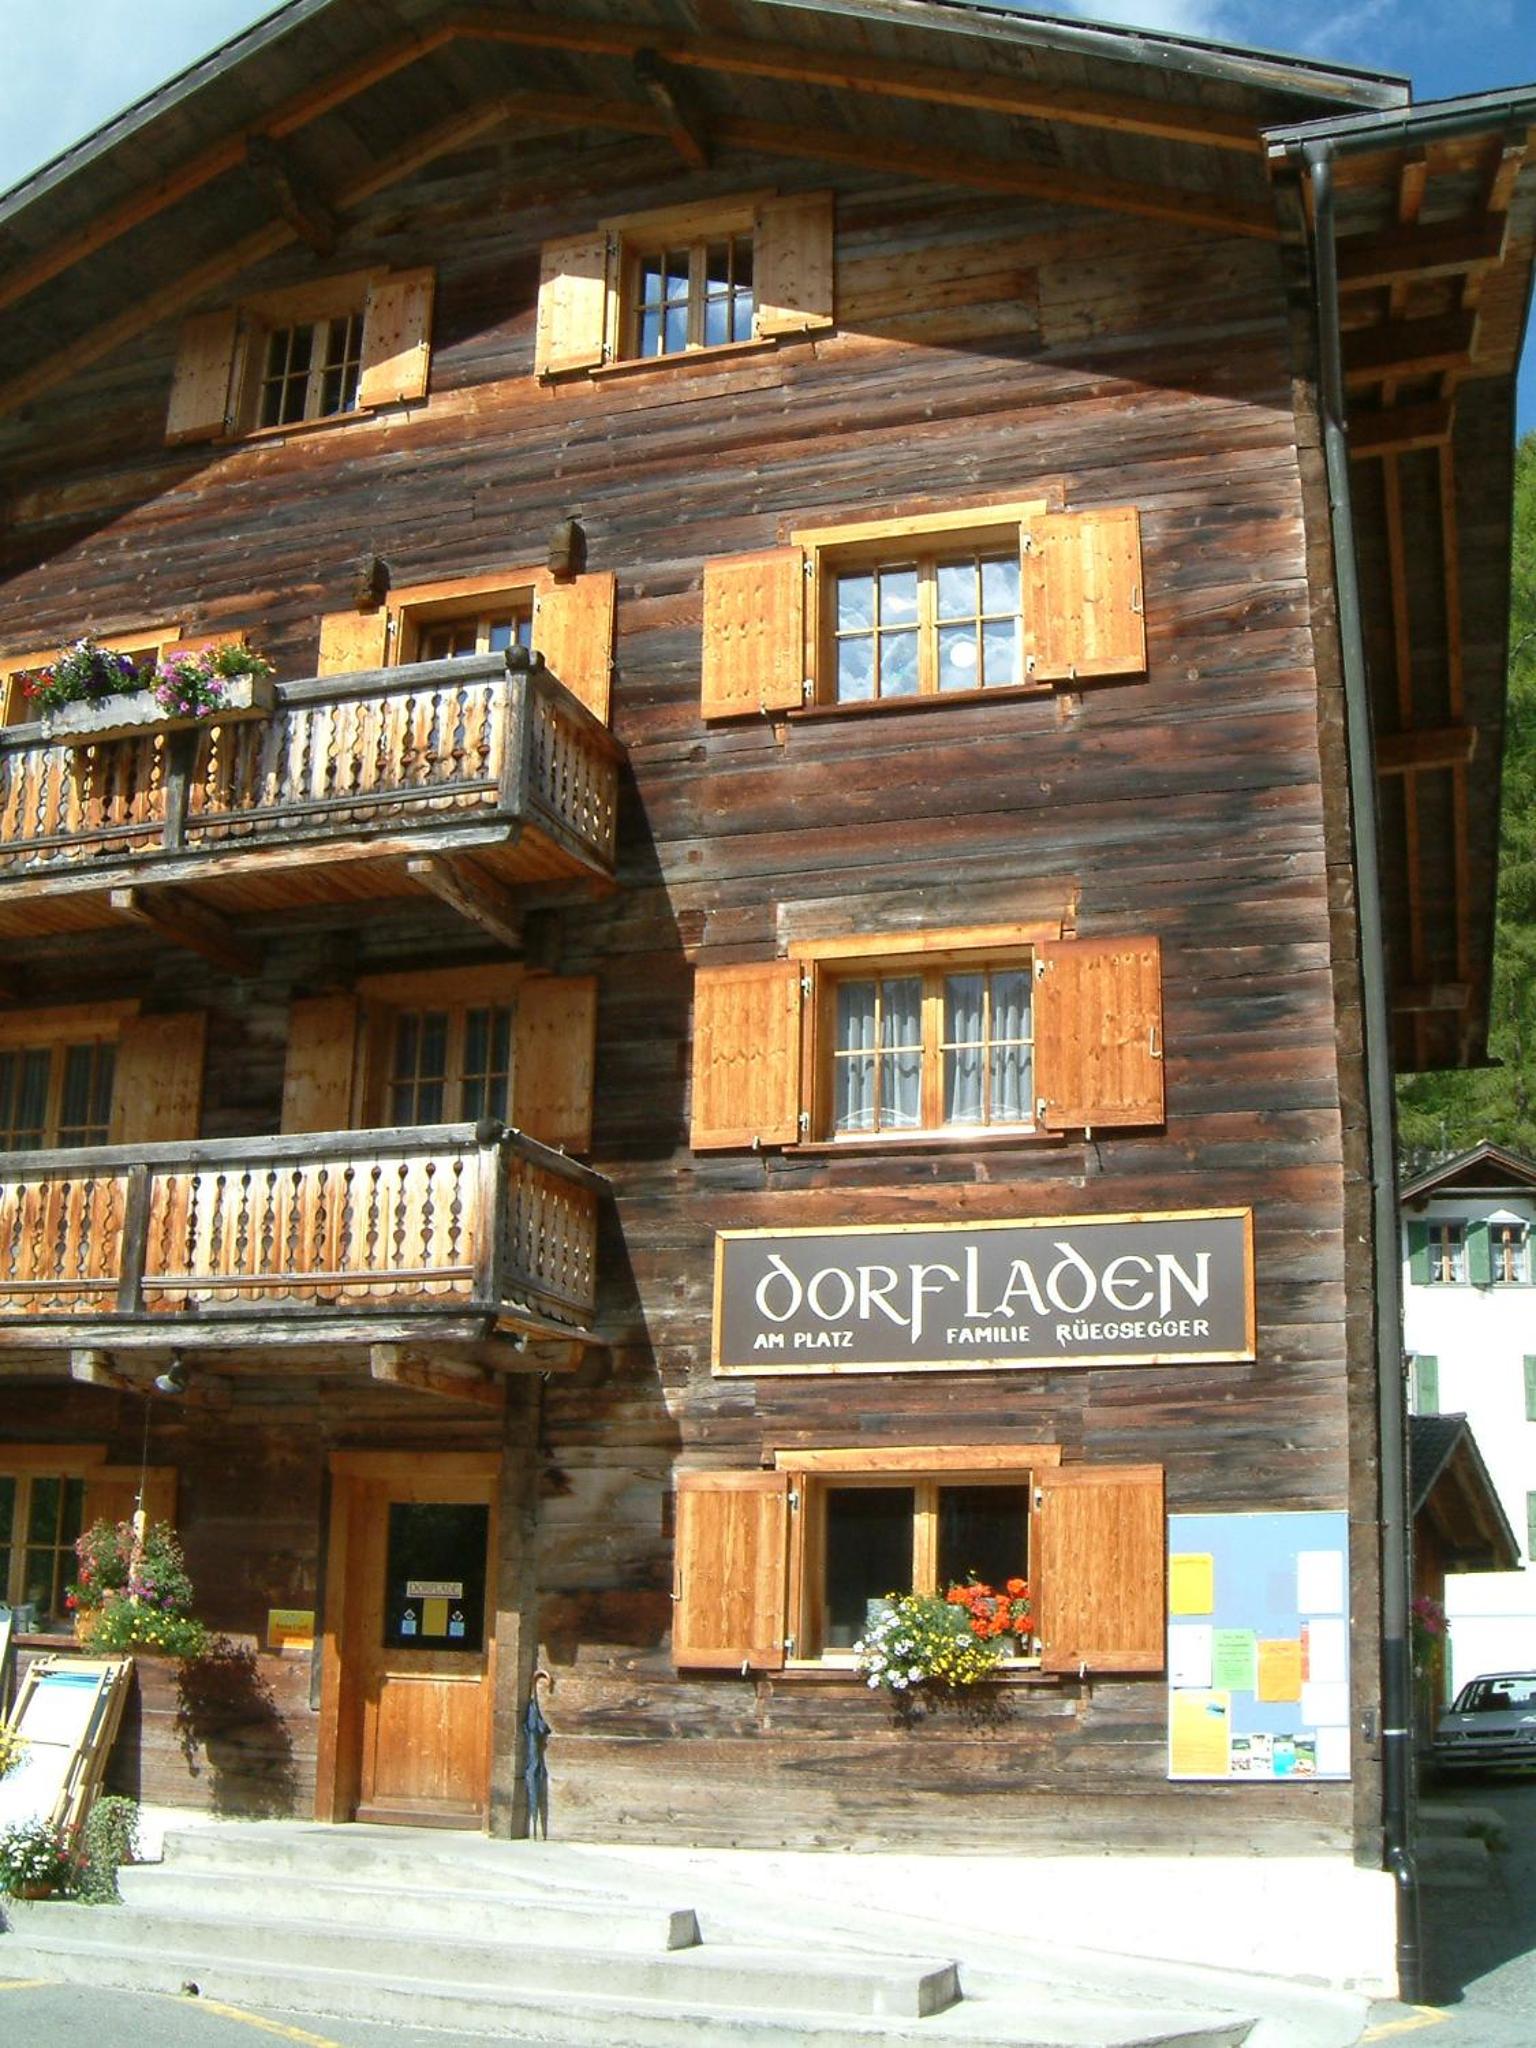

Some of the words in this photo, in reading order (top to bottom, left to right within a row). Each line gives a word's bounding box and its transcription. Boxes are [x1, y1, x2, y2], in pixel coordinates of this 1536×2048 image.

[753, 1332, 785, 1350] AM
[793, 1330, 854, 1349] PLATZ
[946, 1325, 1031, 1345] FAMILIE
[1055, 1318, 1211, 1349] RÜEGSEGGER
